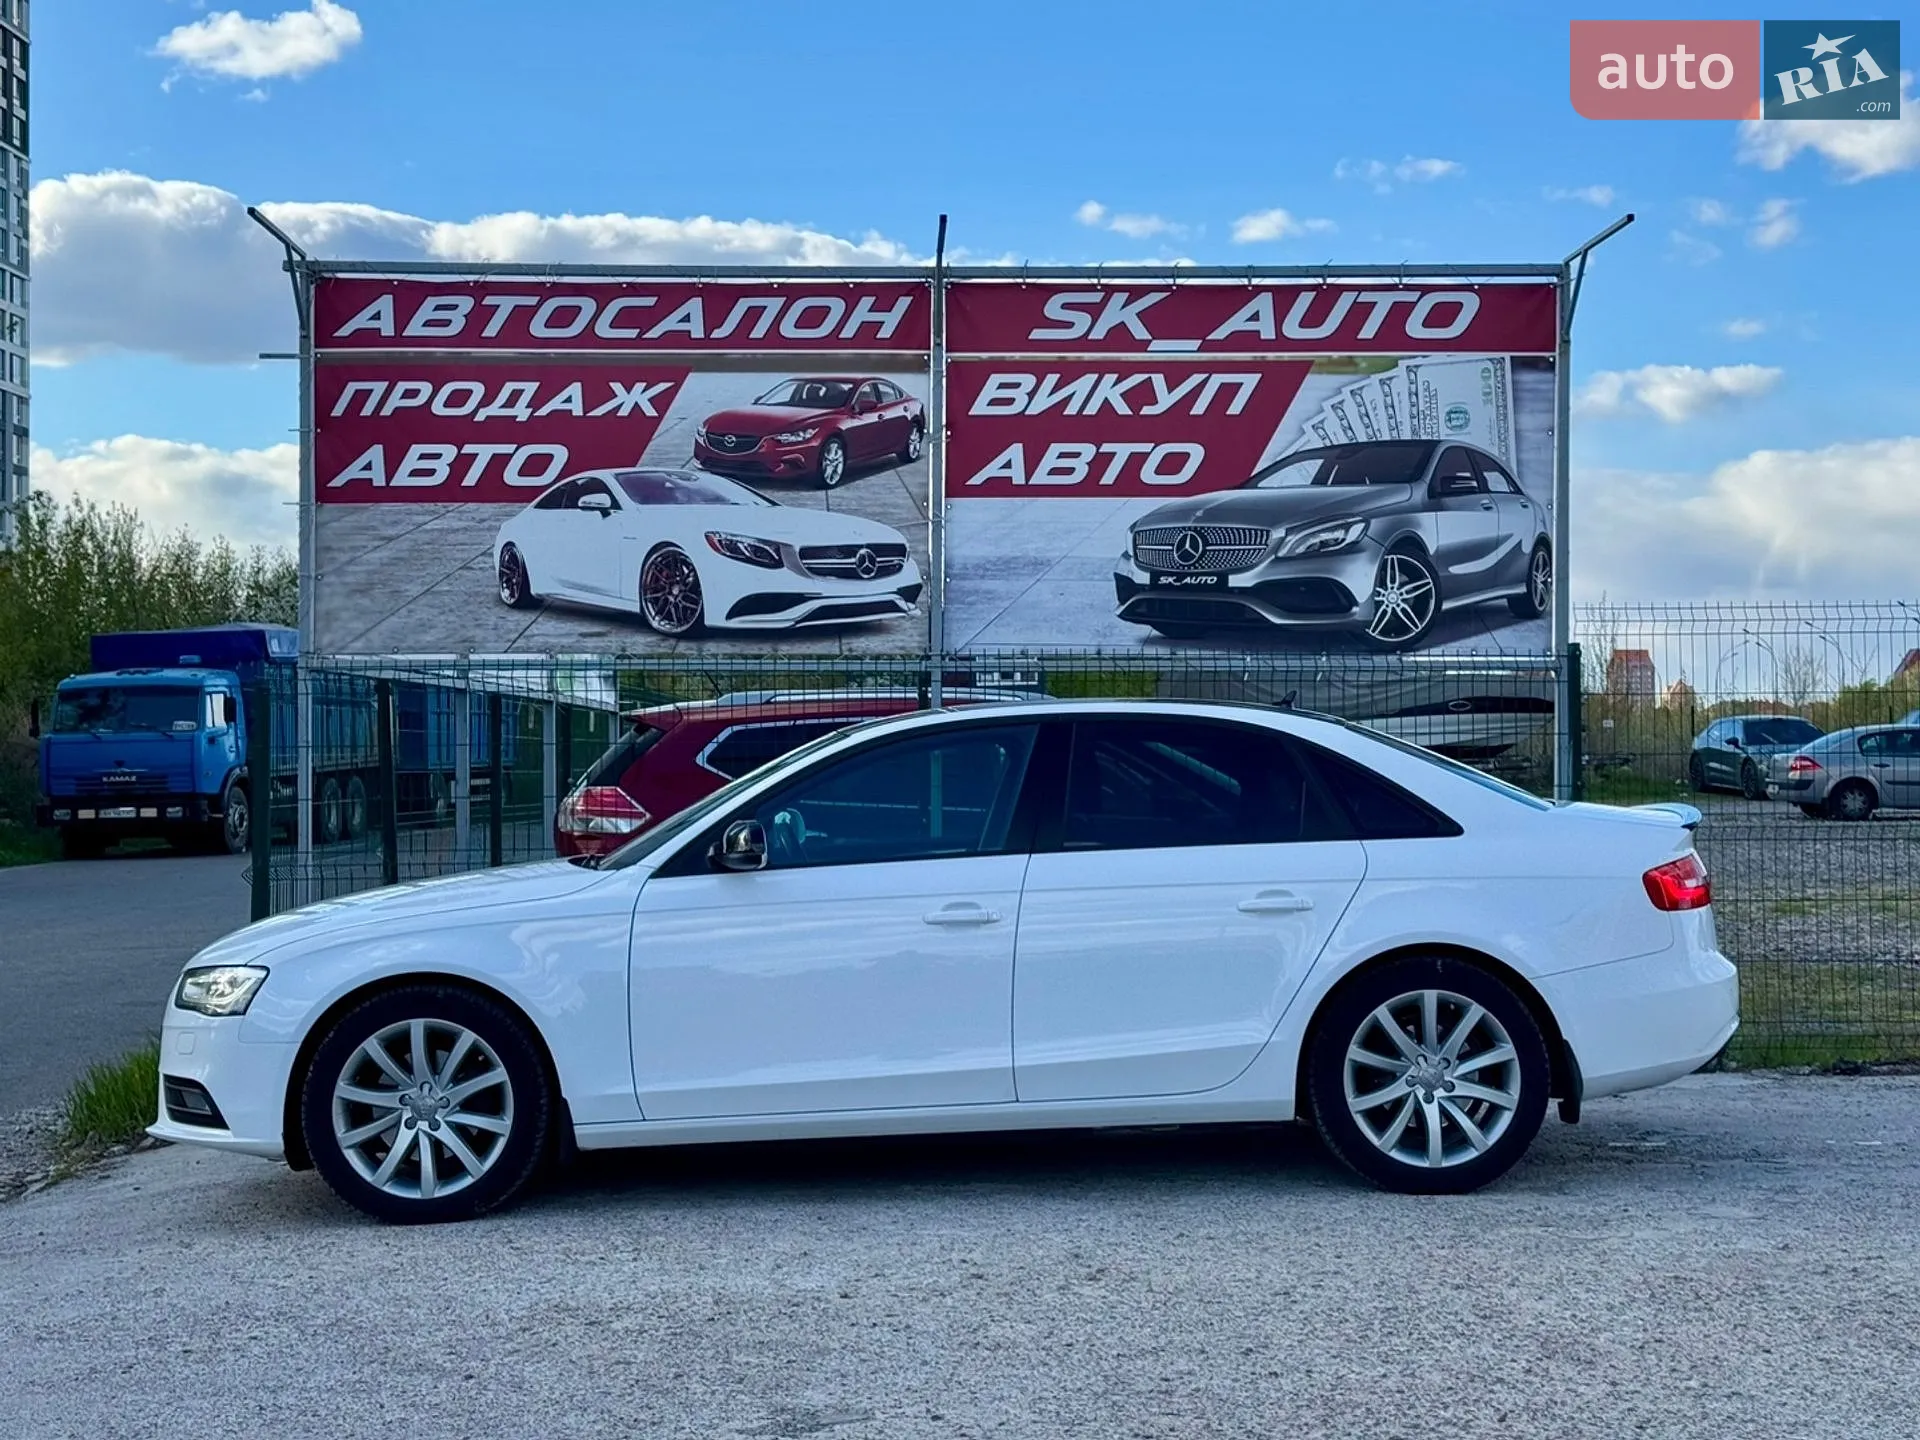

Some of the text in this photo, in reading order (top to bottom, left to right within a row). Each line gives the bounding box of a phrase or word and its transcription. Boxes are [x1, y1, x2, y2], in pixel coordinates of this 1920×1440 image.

[333, 294, 914, 339] АВТОСАЛОН
[1028, 290, 1480, 352] SK_AUTO
[330, 381, 674, 422] ПРОДАЖ
[967, 372, 1263, 416] ВИКУП
[326, 444, 569, 487] АВТО
[965, 442, 1206, 486] АВТО
[1157, 575, 1218, 586] SK_AUTO
